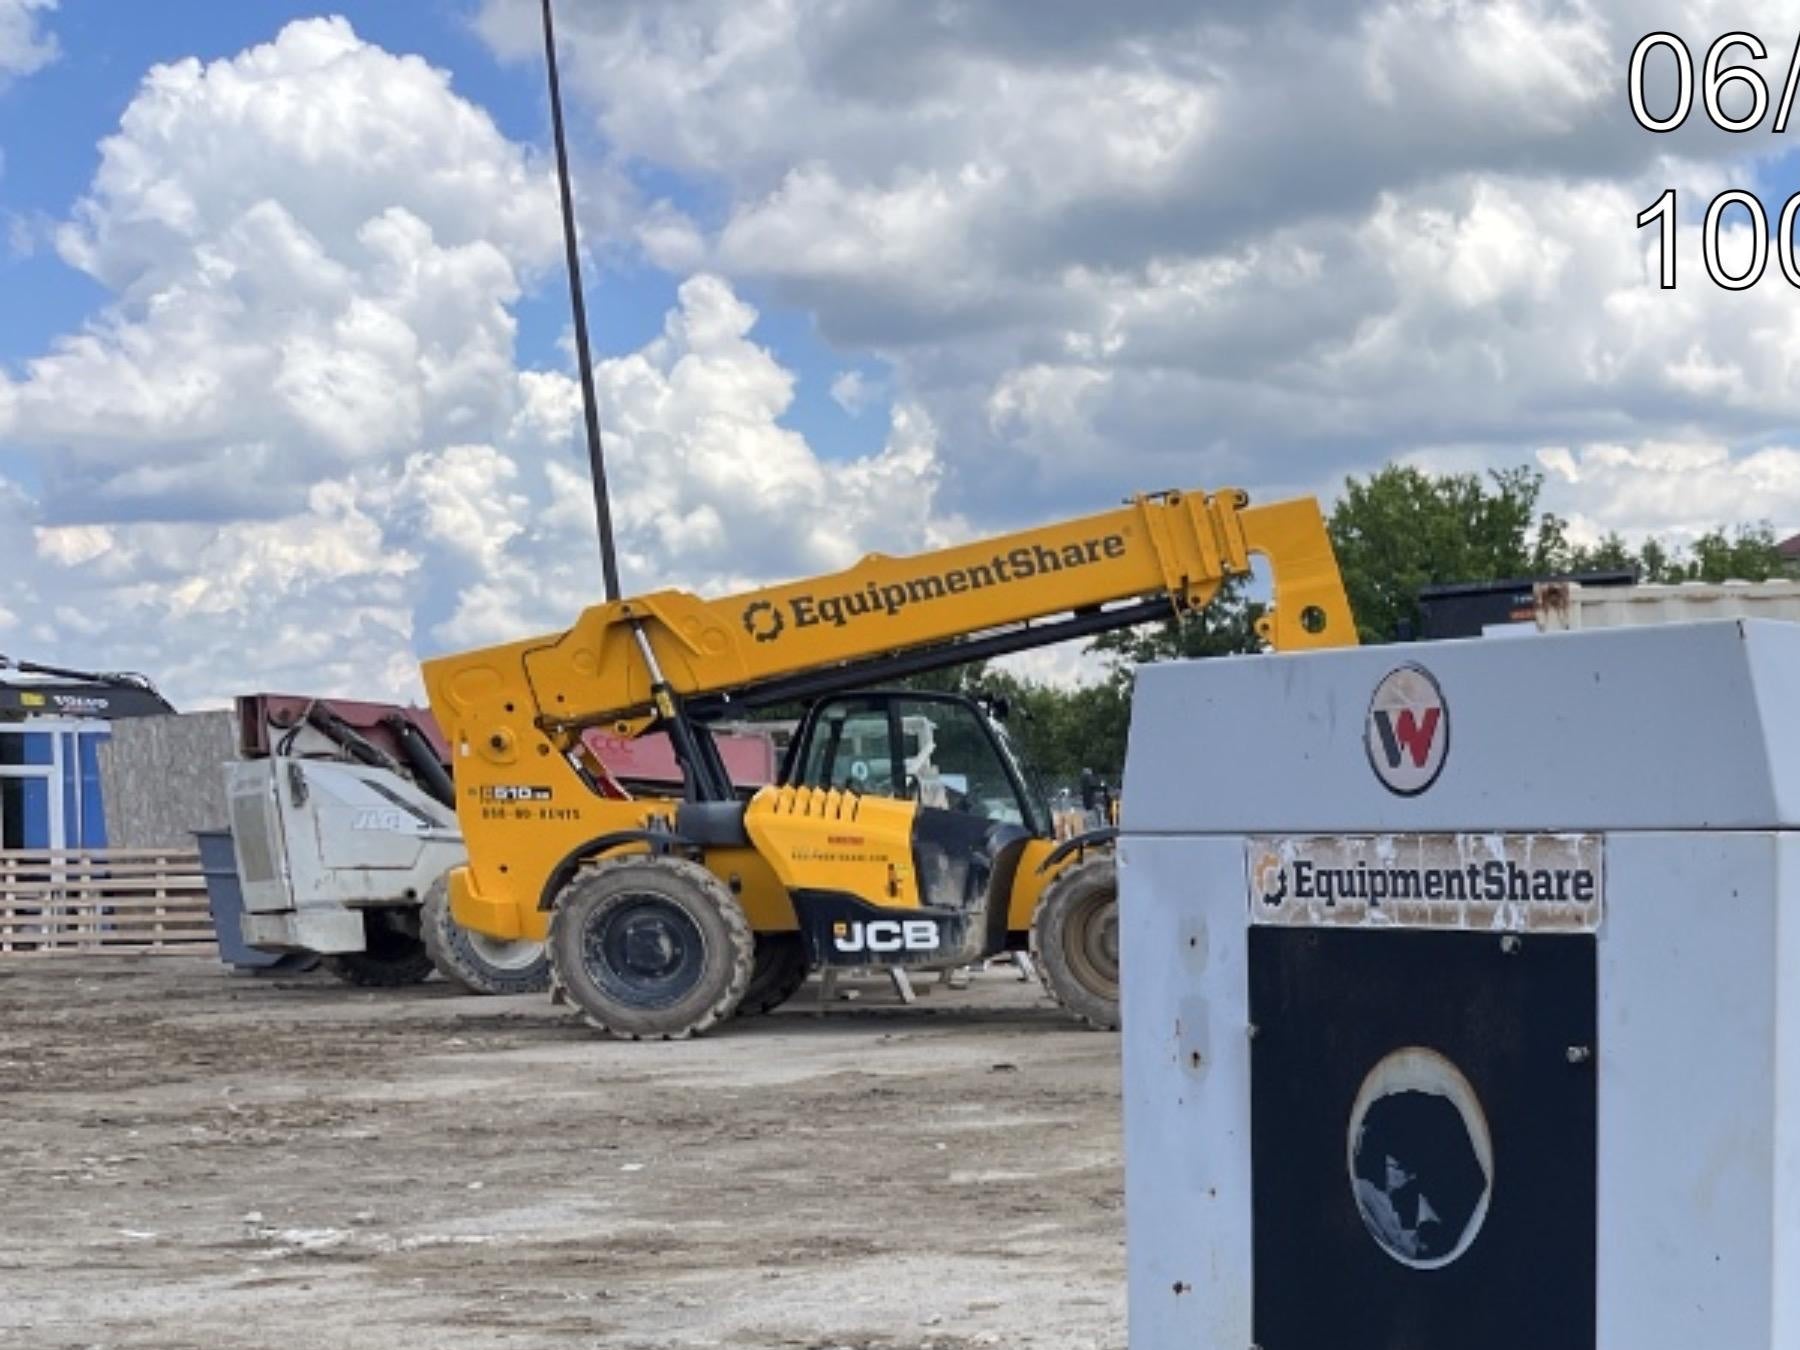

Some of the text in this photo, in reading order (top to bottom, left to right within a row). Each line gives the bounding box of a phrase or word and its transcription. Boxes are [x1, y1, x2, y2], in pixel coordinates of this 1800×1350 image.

[788, 532, 1126, 629] EquipmentShare
[1374, 707, 1441, 768] W
[1292, 859, 1595, 907] EquipmentShare
[833, 919, 940, 952] JCB
